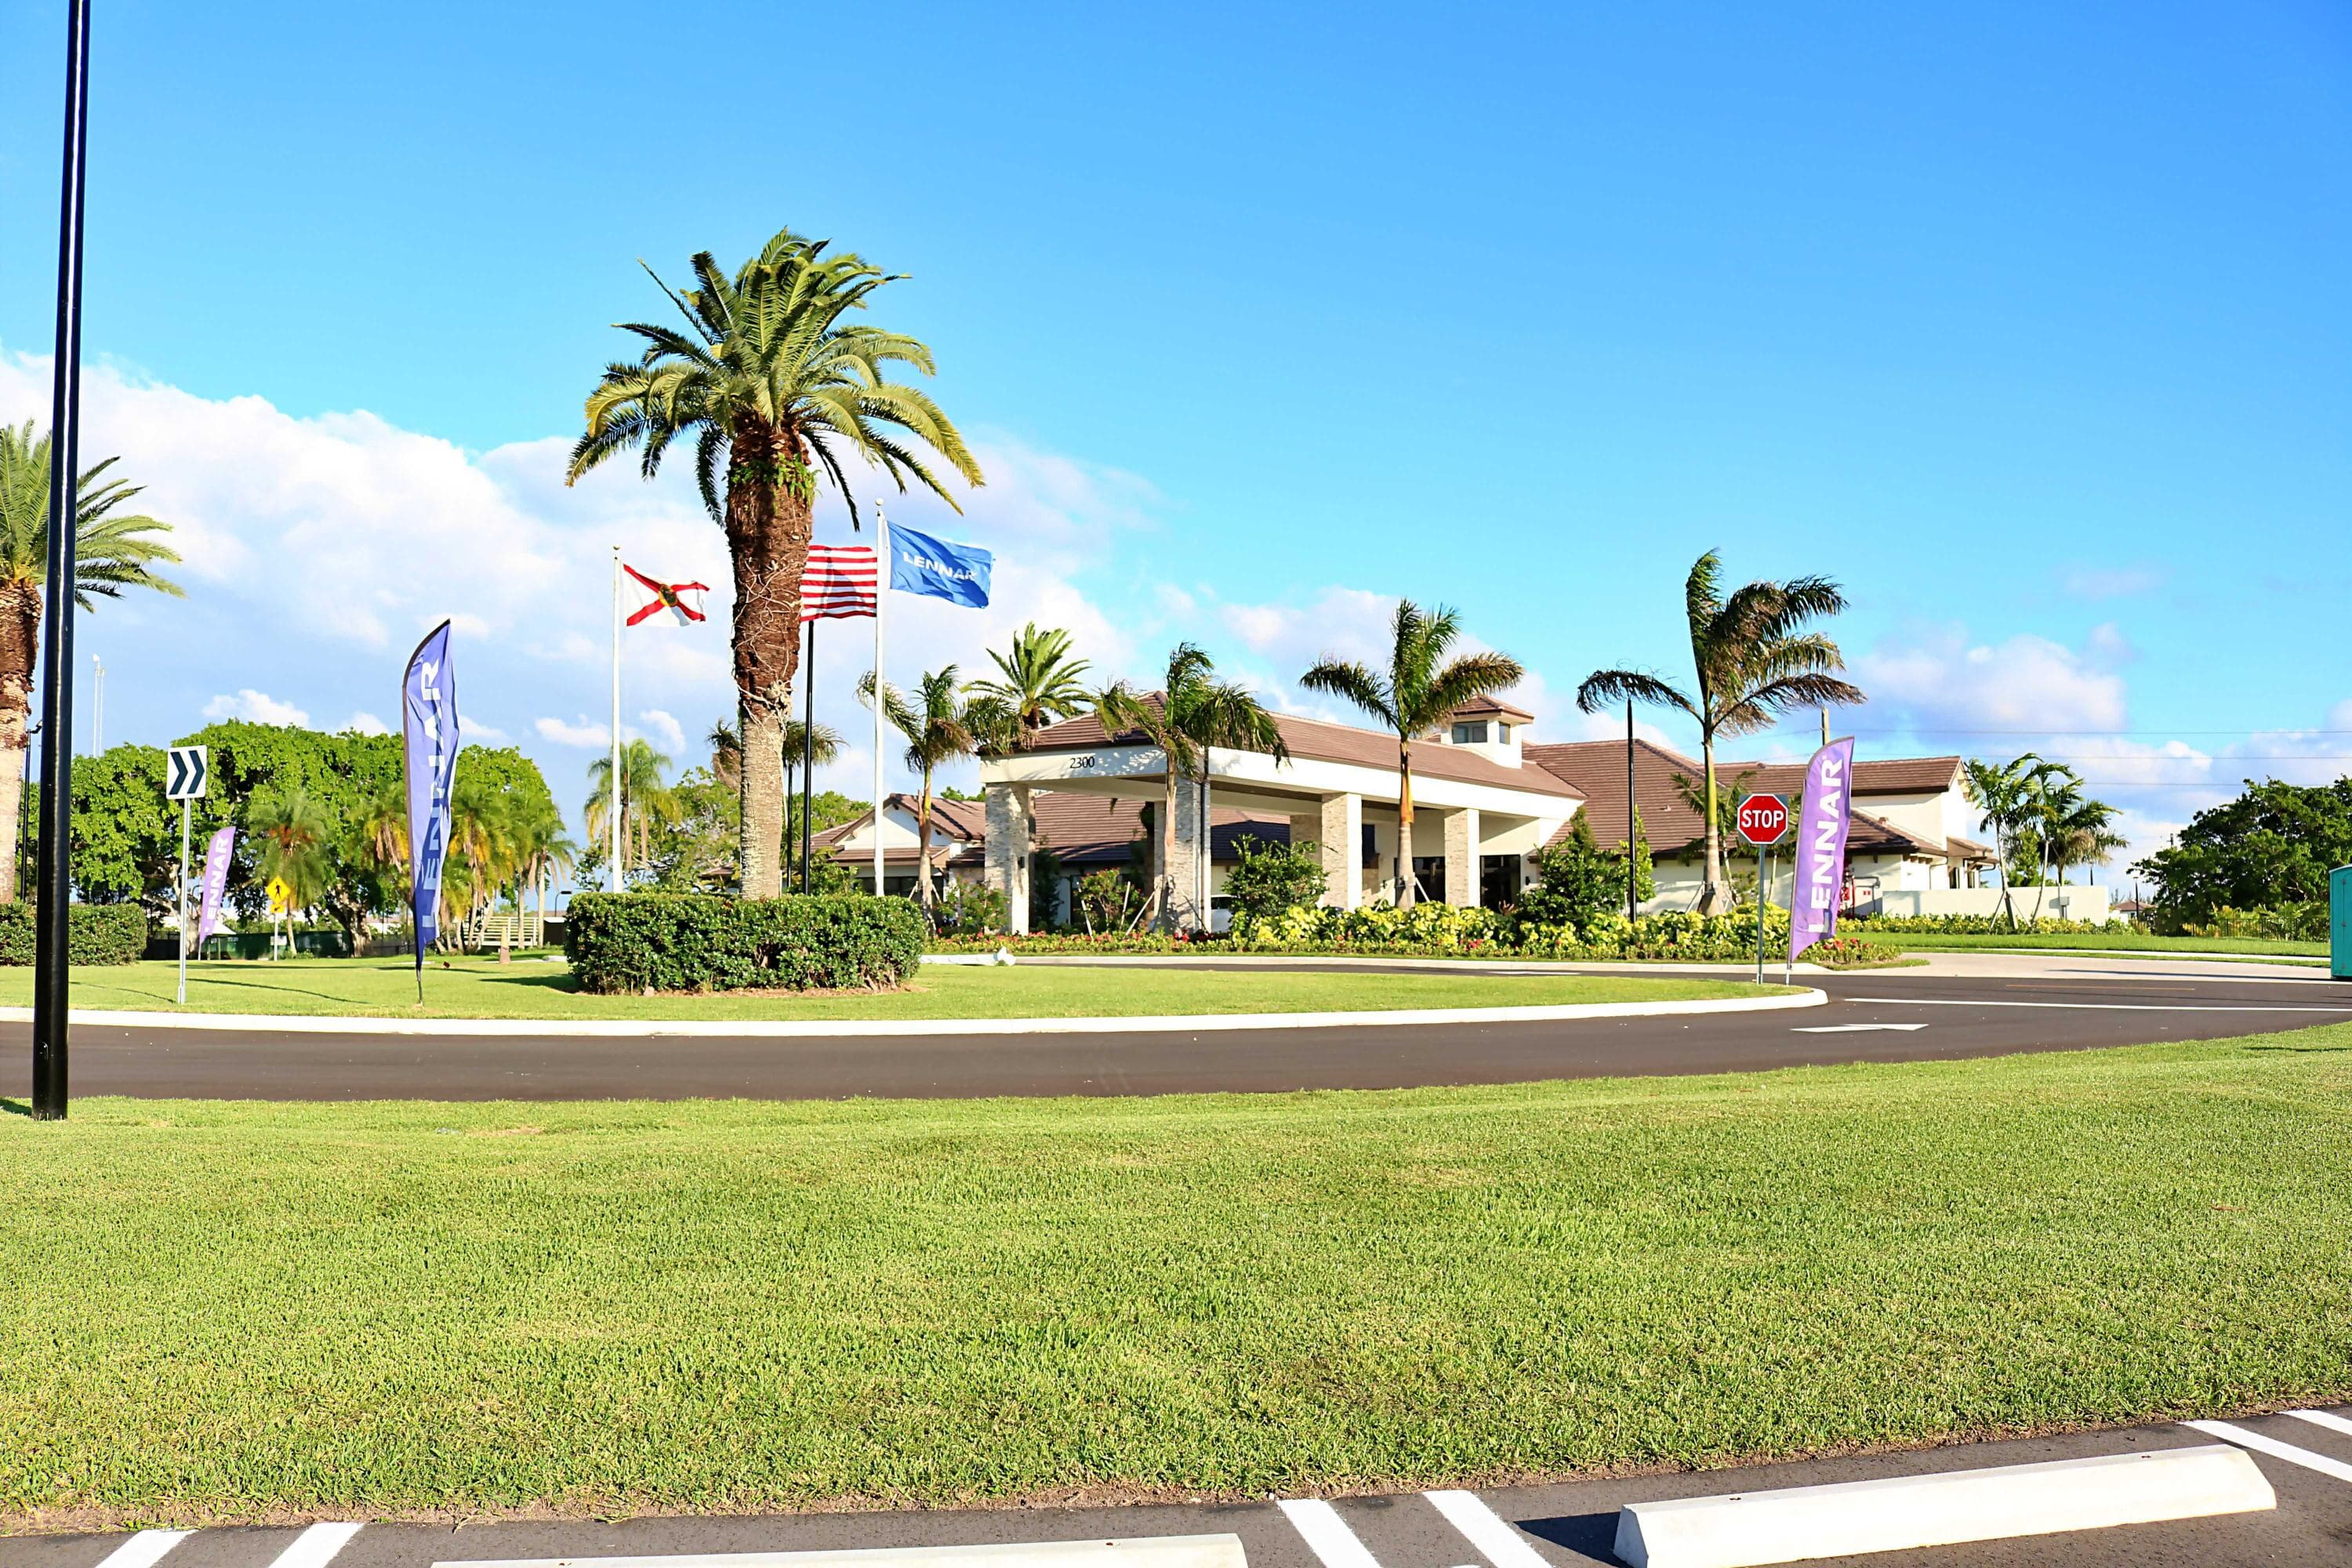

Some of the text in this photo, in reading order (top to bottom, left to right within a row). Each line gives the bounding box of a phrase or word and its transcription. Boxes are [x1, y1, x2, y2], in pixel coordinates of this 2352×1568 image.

[902, 551, 977, 580] LENNAR
[1069, 757, 1095, 768] 2300
[1741, 809, 1784, 829] STOP
[1808, 758, 1843, 934] LENNAR
[205, 837, 229, 933] ENNAR
